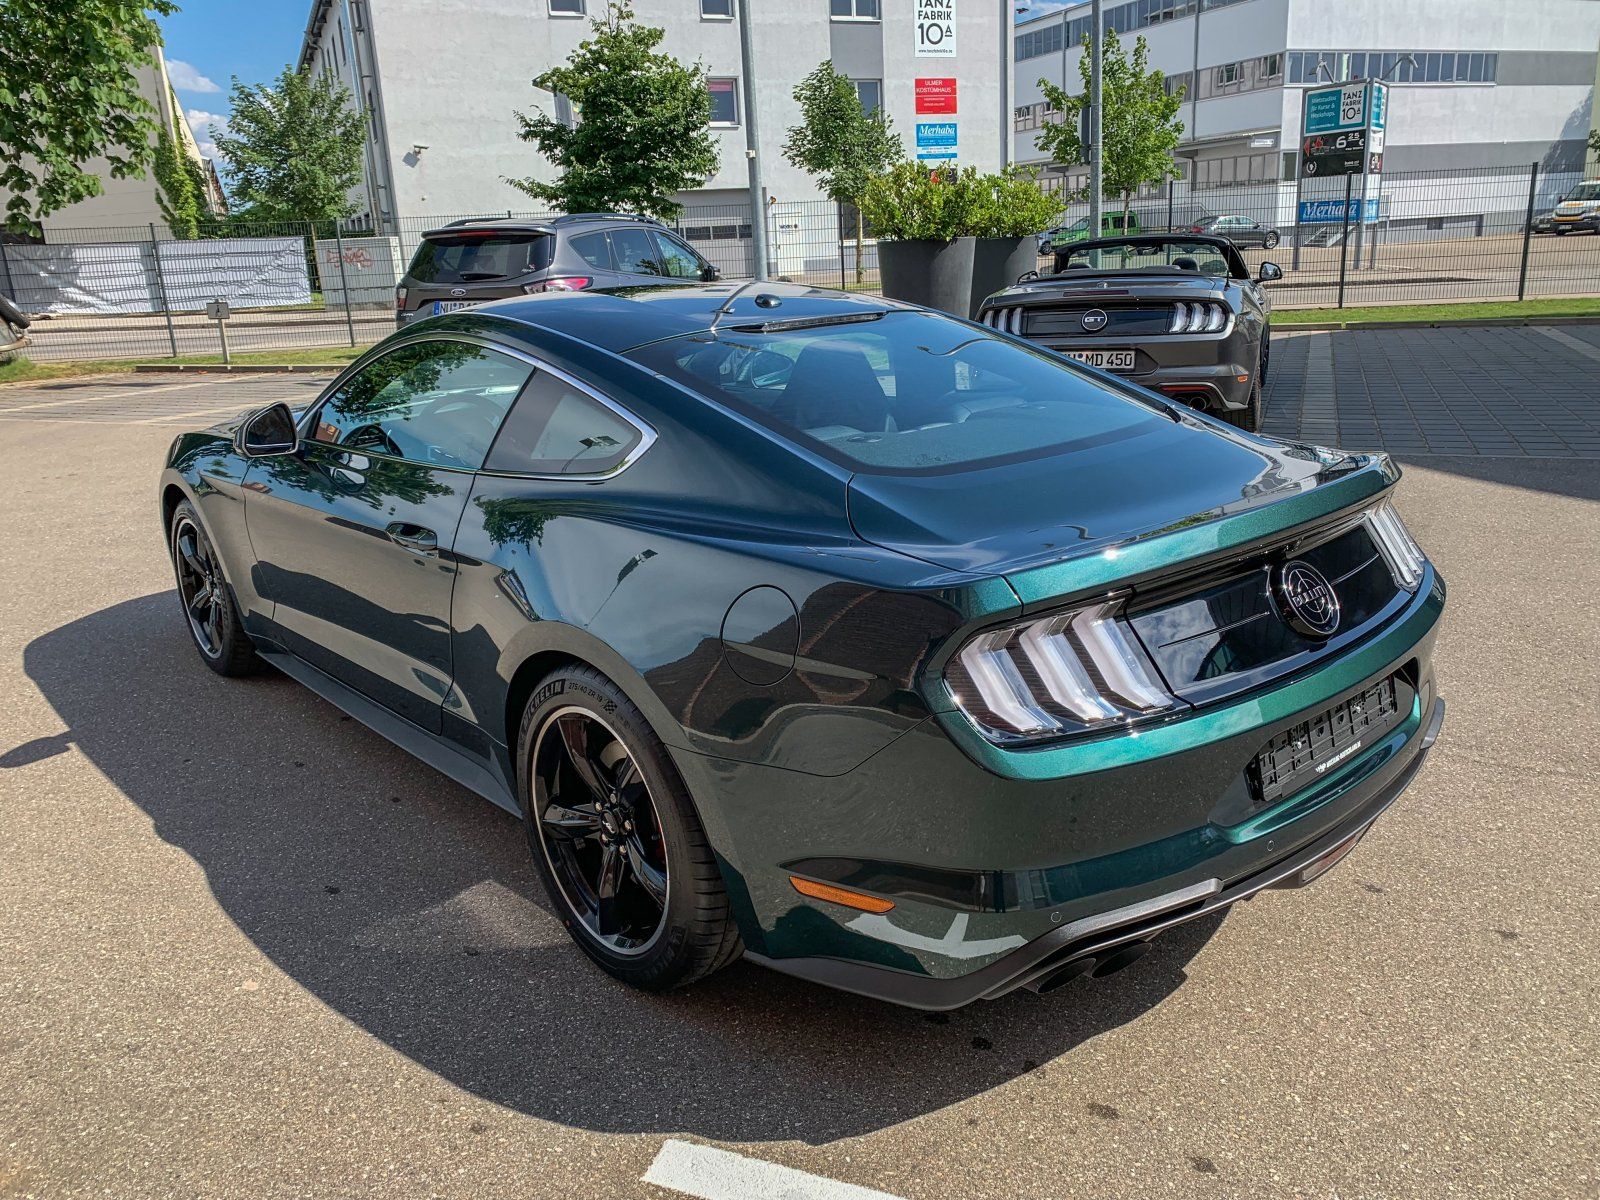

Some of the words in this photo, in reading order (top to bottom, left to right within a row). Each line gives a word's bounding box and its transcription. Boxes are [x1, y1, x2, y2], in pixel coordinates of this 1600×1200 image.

[918, 10, 952, 20] FABRIK
[1343, 91, 1362, 100] TANZ
[1342, 99, 1361, 107] FABRIK
[920, 124, 955, 135] Merhaba
[1336, 136, 1346, 148] 6
[1348, 132, 1360, 140] 25
[1107, 353, 1132, 366] 450
[521, 680, 562, 732] MICHELIN
[587, 689, 596, 698] ZR
[597, 694, 603, 703] 19
